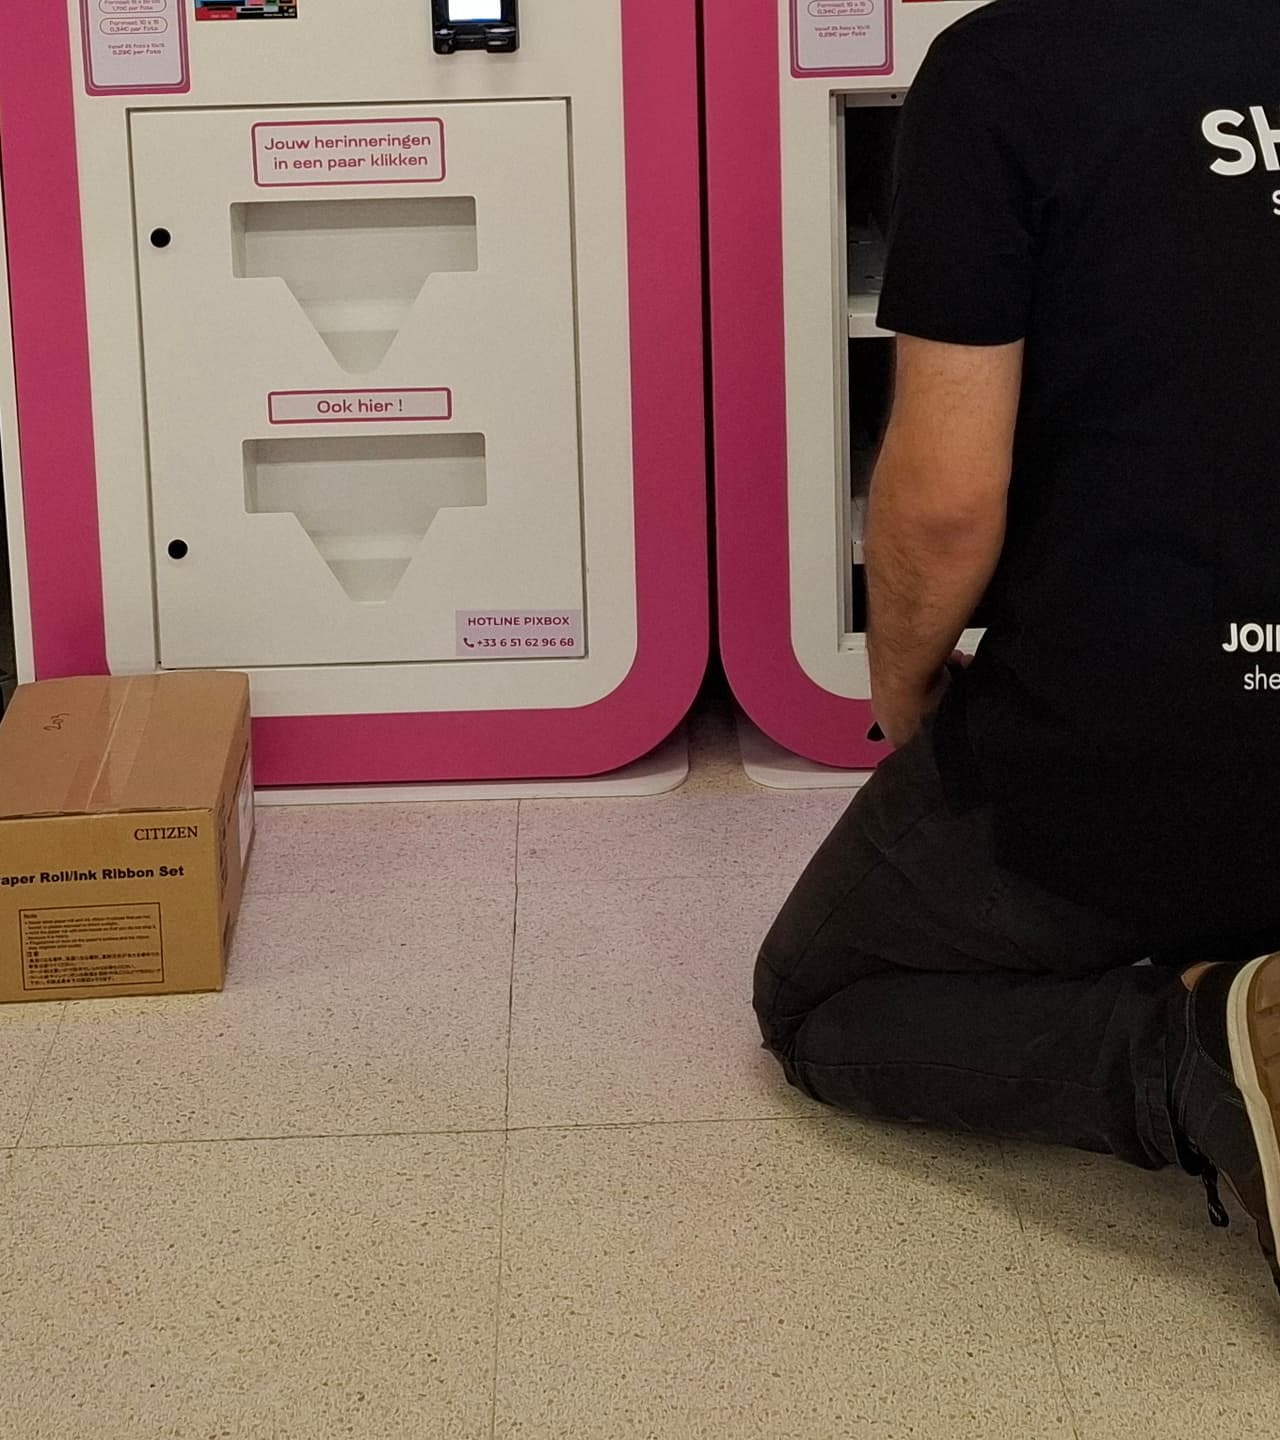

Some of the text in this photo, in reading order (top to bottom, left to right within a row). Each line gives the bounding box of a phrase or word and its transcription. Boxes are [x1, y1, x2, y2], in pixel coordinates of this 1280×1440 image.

[265, 133, 431, 152] Jouw herinneringen
[273, 152, 428, 172] in een paar klikken
[317, 398, 394, 414] Ook hier
[468, 616, 570, 626] HOTLINE PIXBOX
[477, 638, 574, 648] +33 6 51 62 96 68
[134, 826, 199, 841] CITIZEN
[40, 870, 98, 884] Roll/Ink
[102, 867, 154, 881] Ribbon
[159, 865, 185, 877] Set
